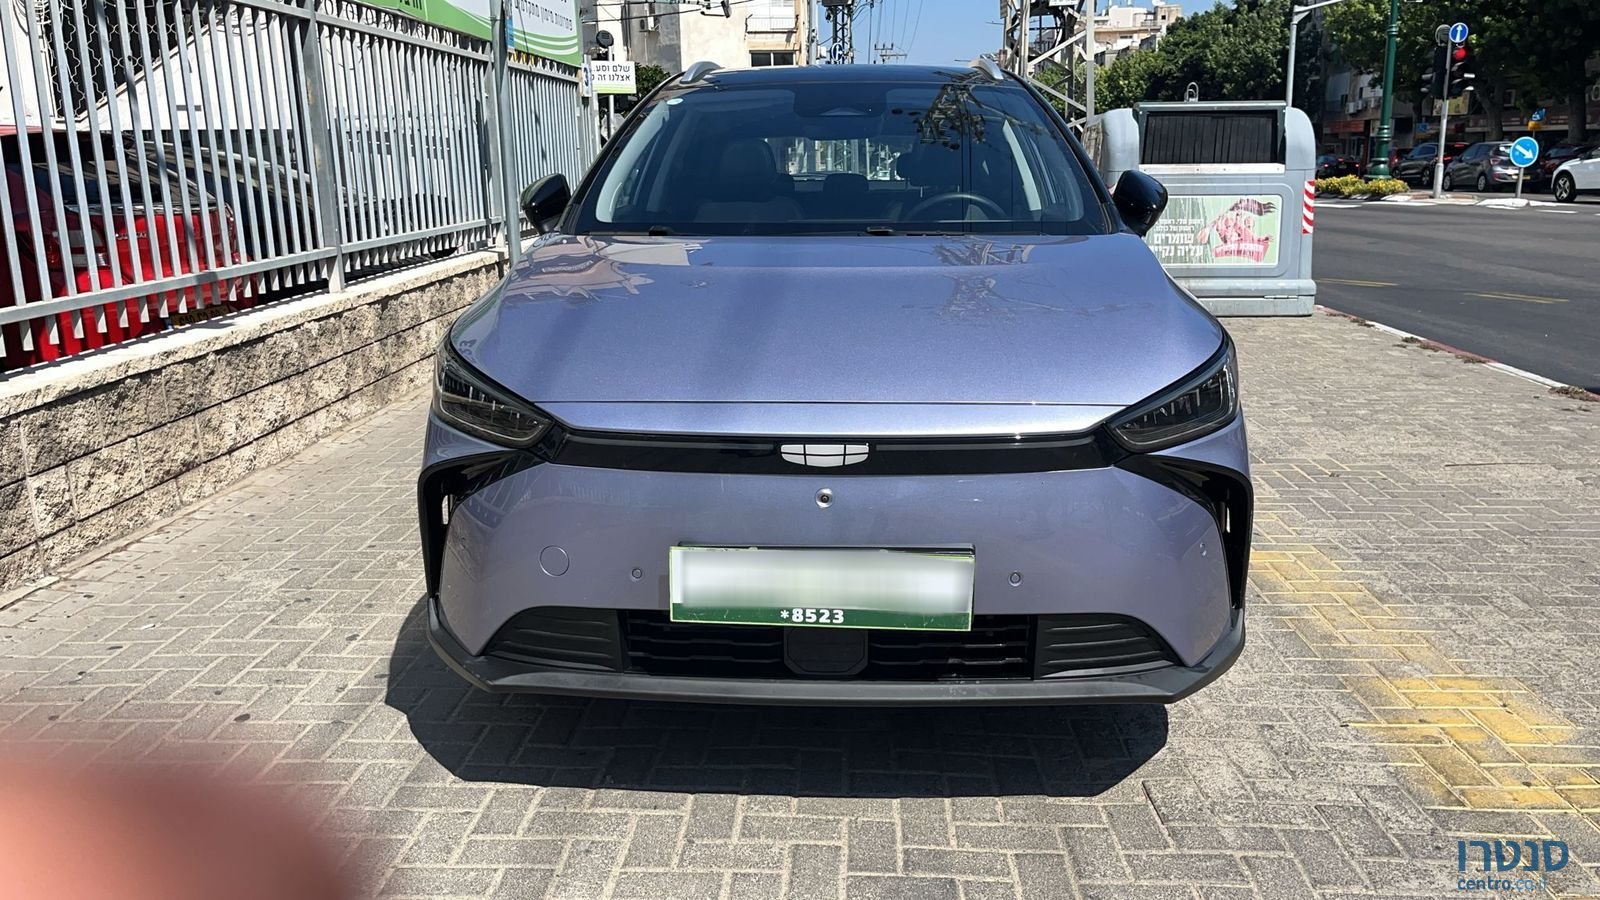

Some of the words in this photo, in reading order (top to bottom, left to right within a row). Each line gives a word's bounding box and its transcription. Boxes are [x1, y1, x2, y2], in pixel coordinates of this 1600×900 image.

[612, 64, 630, 72] שלם
[609, 73, 631, 82] אצלנו
[1153, 233, 1195, 245] שומרים
[1177, 243, 1204, 257] עליה
